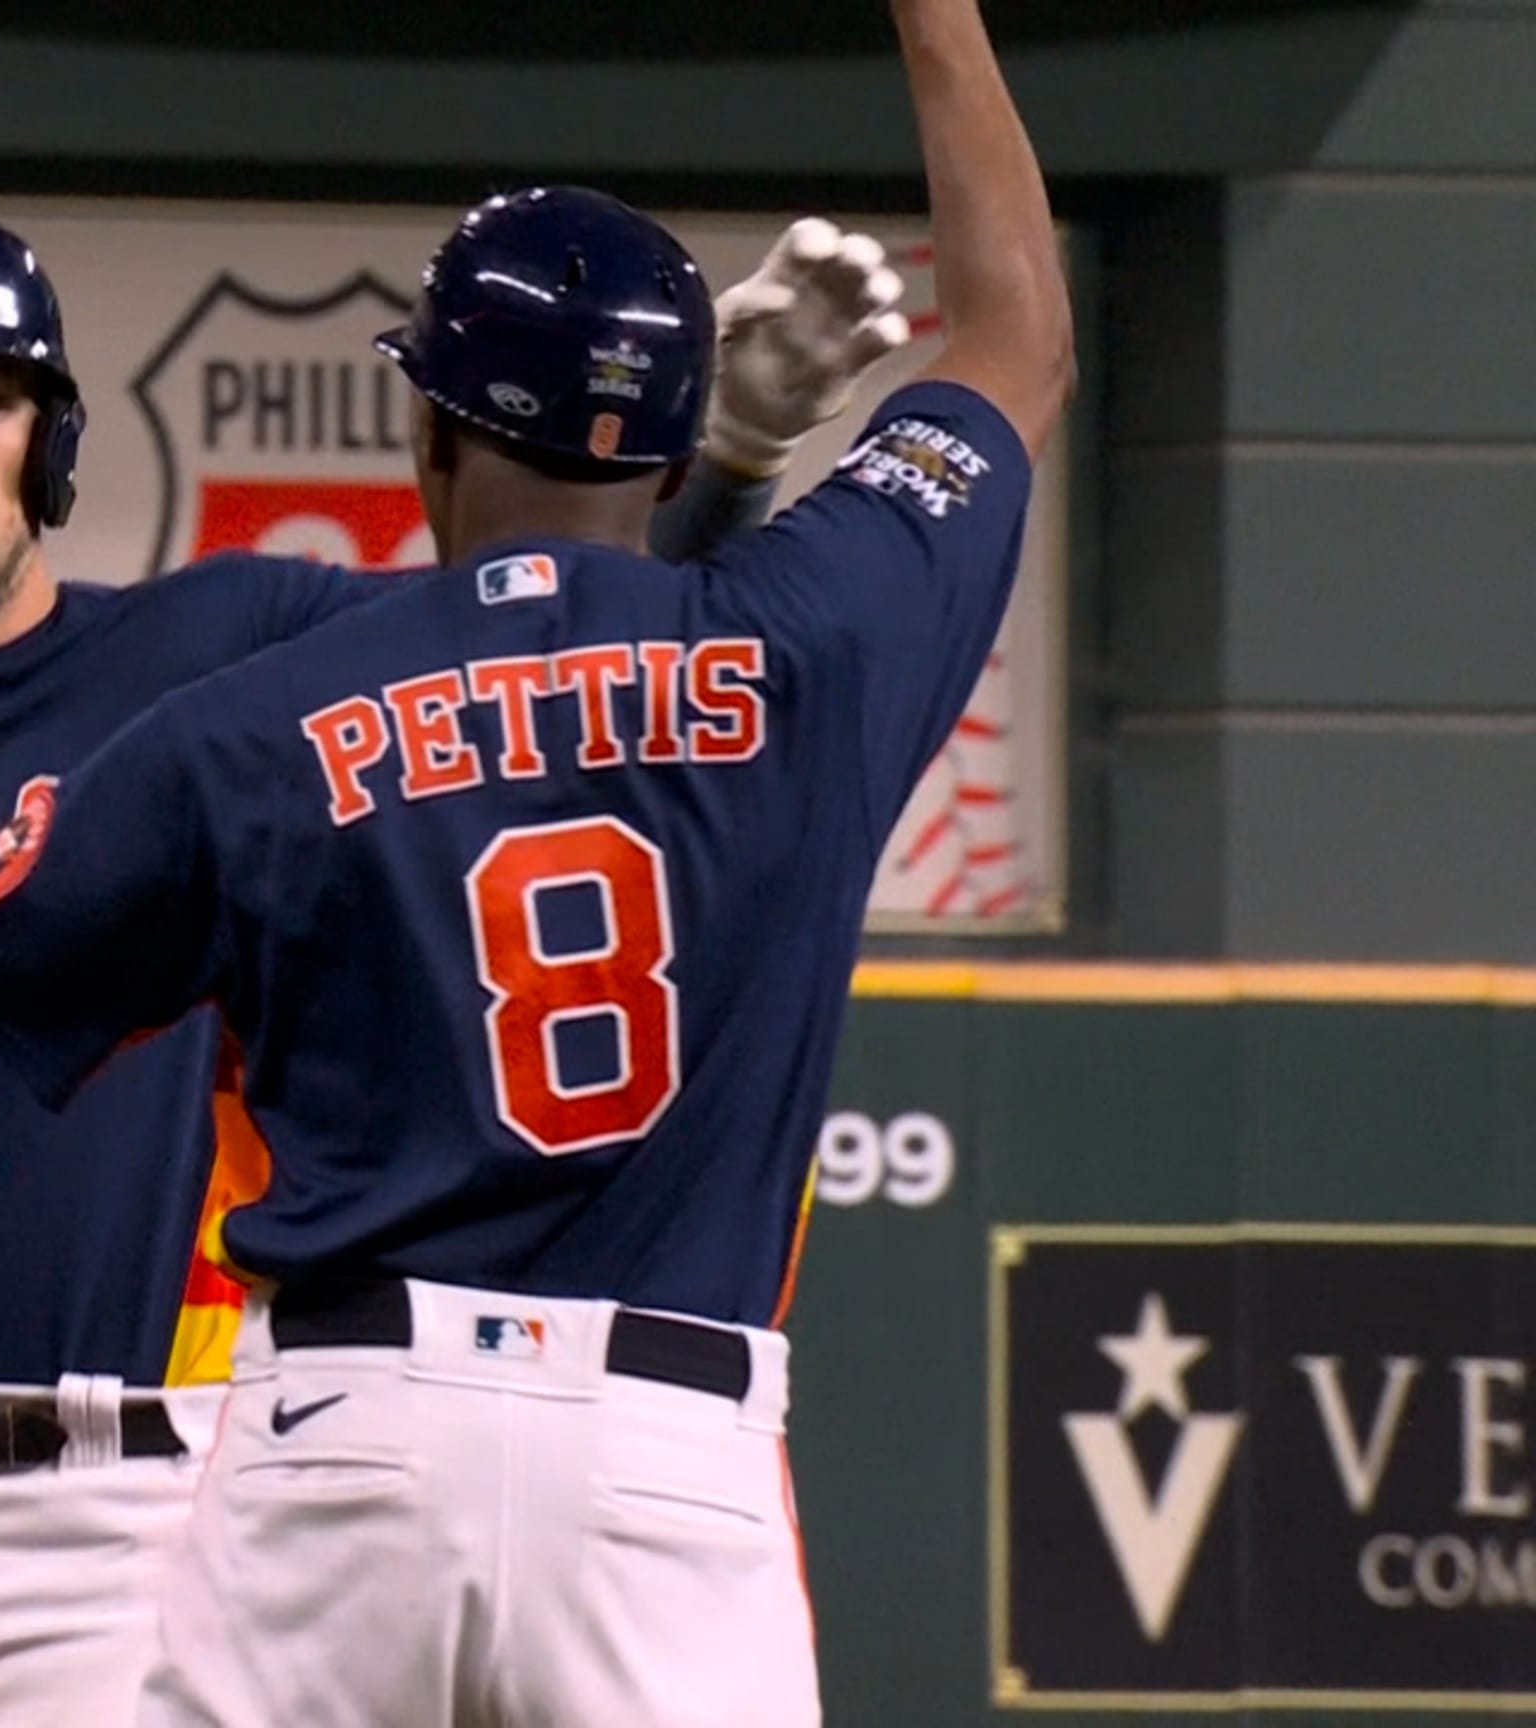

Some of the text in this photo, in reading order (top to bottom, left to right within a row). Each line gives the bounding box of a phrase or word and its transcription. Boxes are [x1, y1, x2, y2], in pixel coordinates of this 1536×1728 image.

[300, 638, 765, 827] PETTIS
[464, 814, 682, 1158] 8
[816, 1110, 955, 1207] 99
[1292, 1354, 1529, 1516] VE
